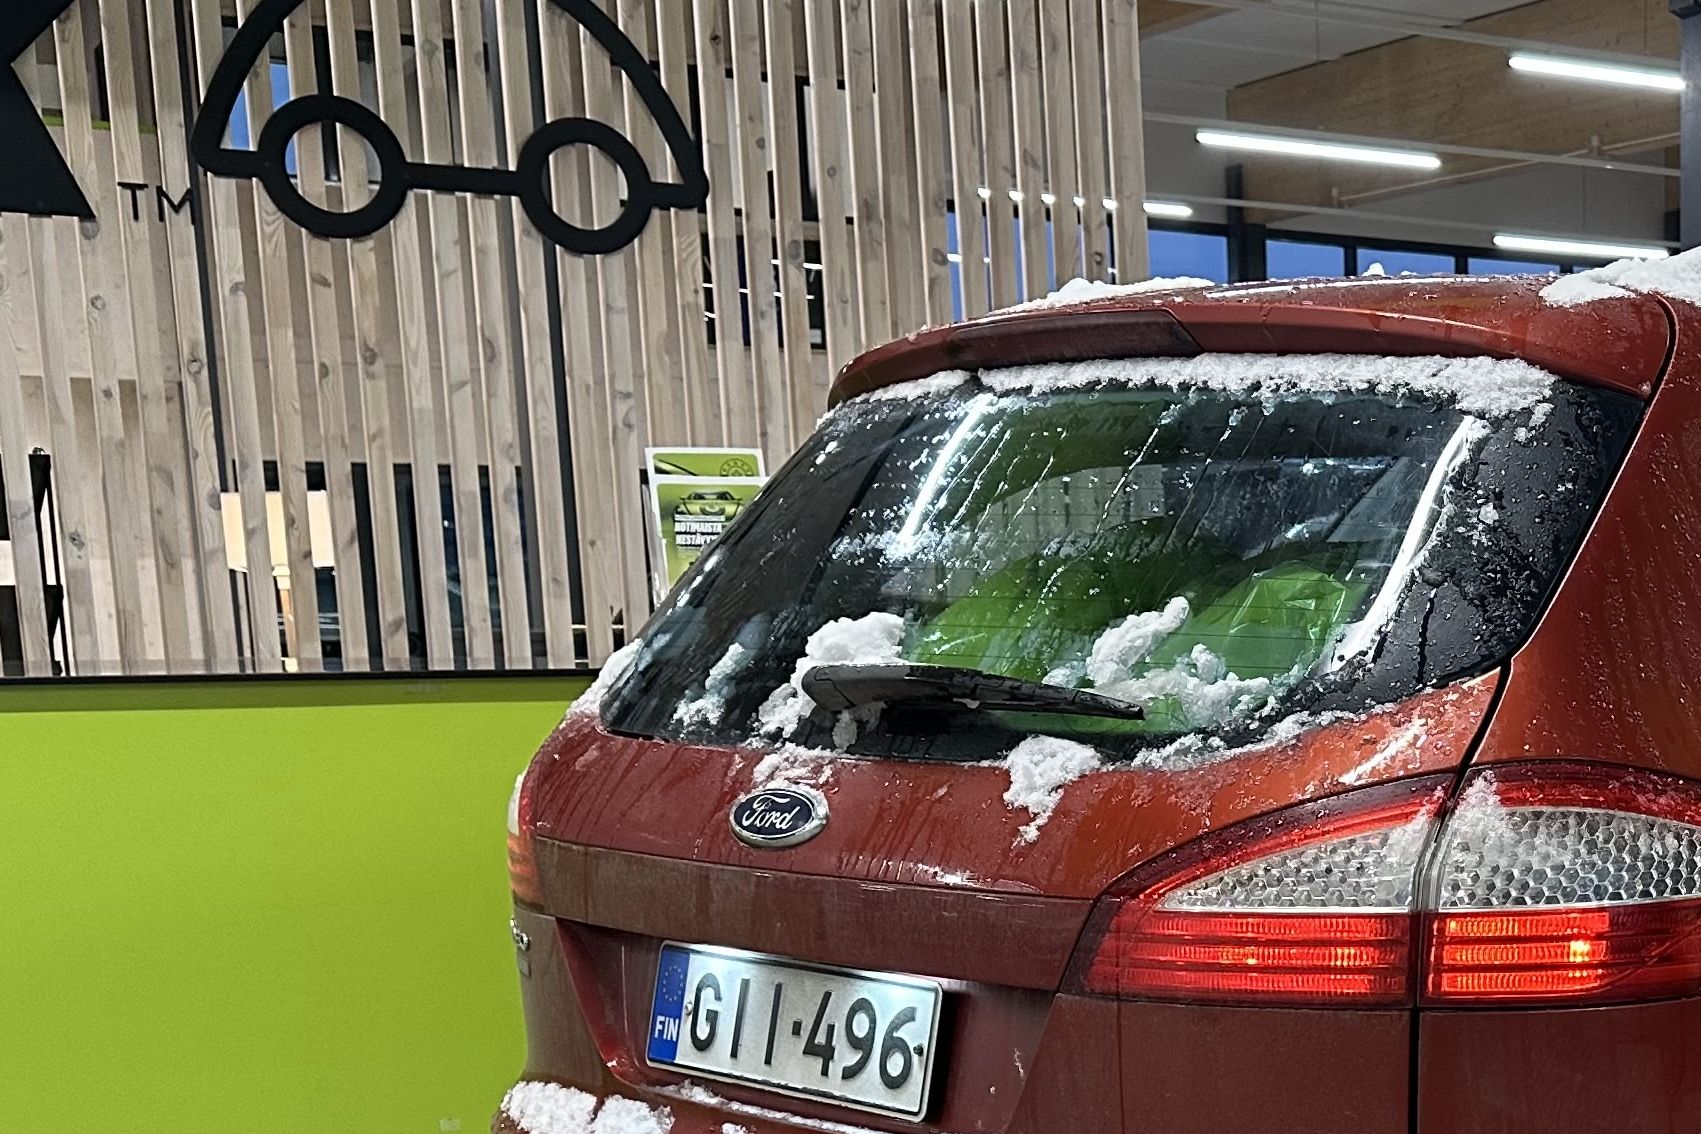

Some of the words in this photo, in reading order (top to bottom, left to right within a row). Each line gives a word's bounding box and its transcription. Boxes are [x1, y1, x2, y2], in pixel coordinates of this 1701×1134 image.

[117, 181, 197, 227] TM
[742, 795, 801, 830] Ford
[653, 1014, 680, 1043] FIN
[689, 971, 918, 1091] GII-496
